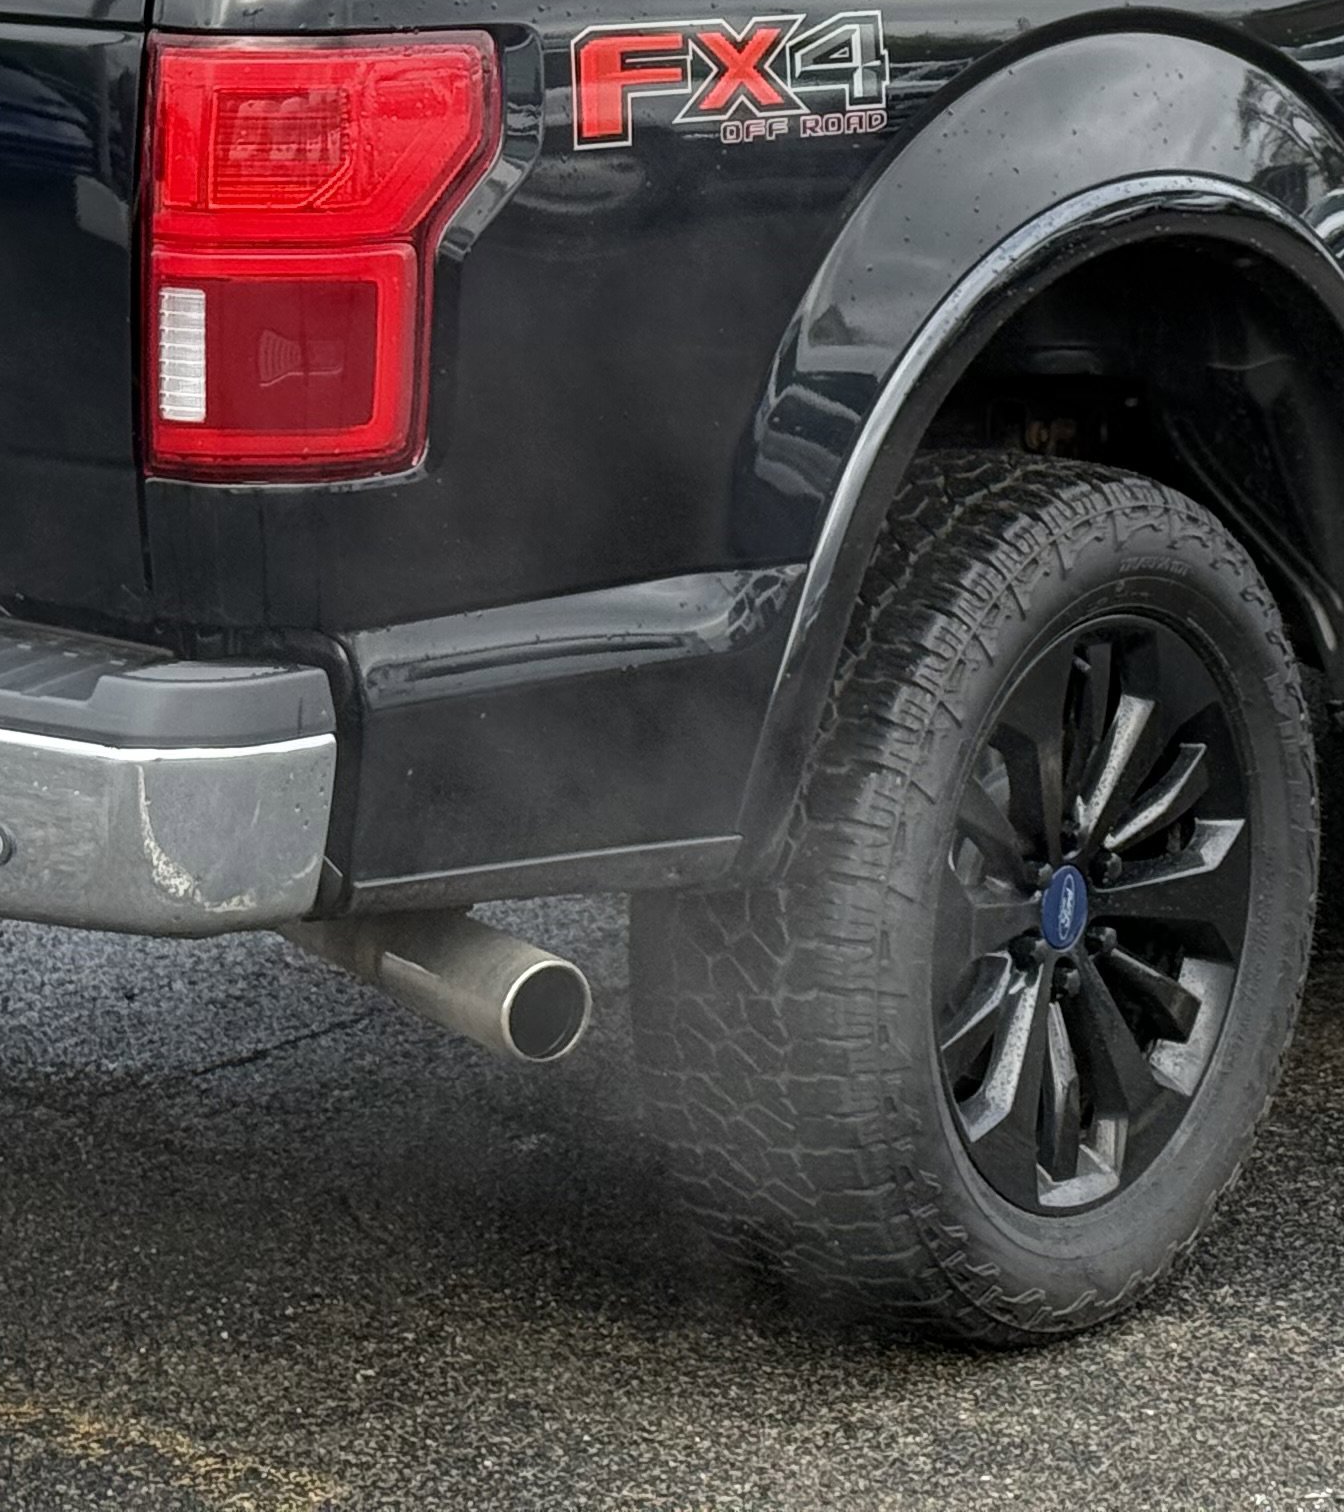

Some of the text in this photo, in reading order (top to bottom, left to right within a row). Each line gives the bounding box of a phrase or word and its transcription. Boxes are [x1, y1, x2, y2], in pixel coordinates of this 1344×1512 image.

[570, 9, 890, 151] FX4
[720, 109, 888, 144] OFF ROAD
